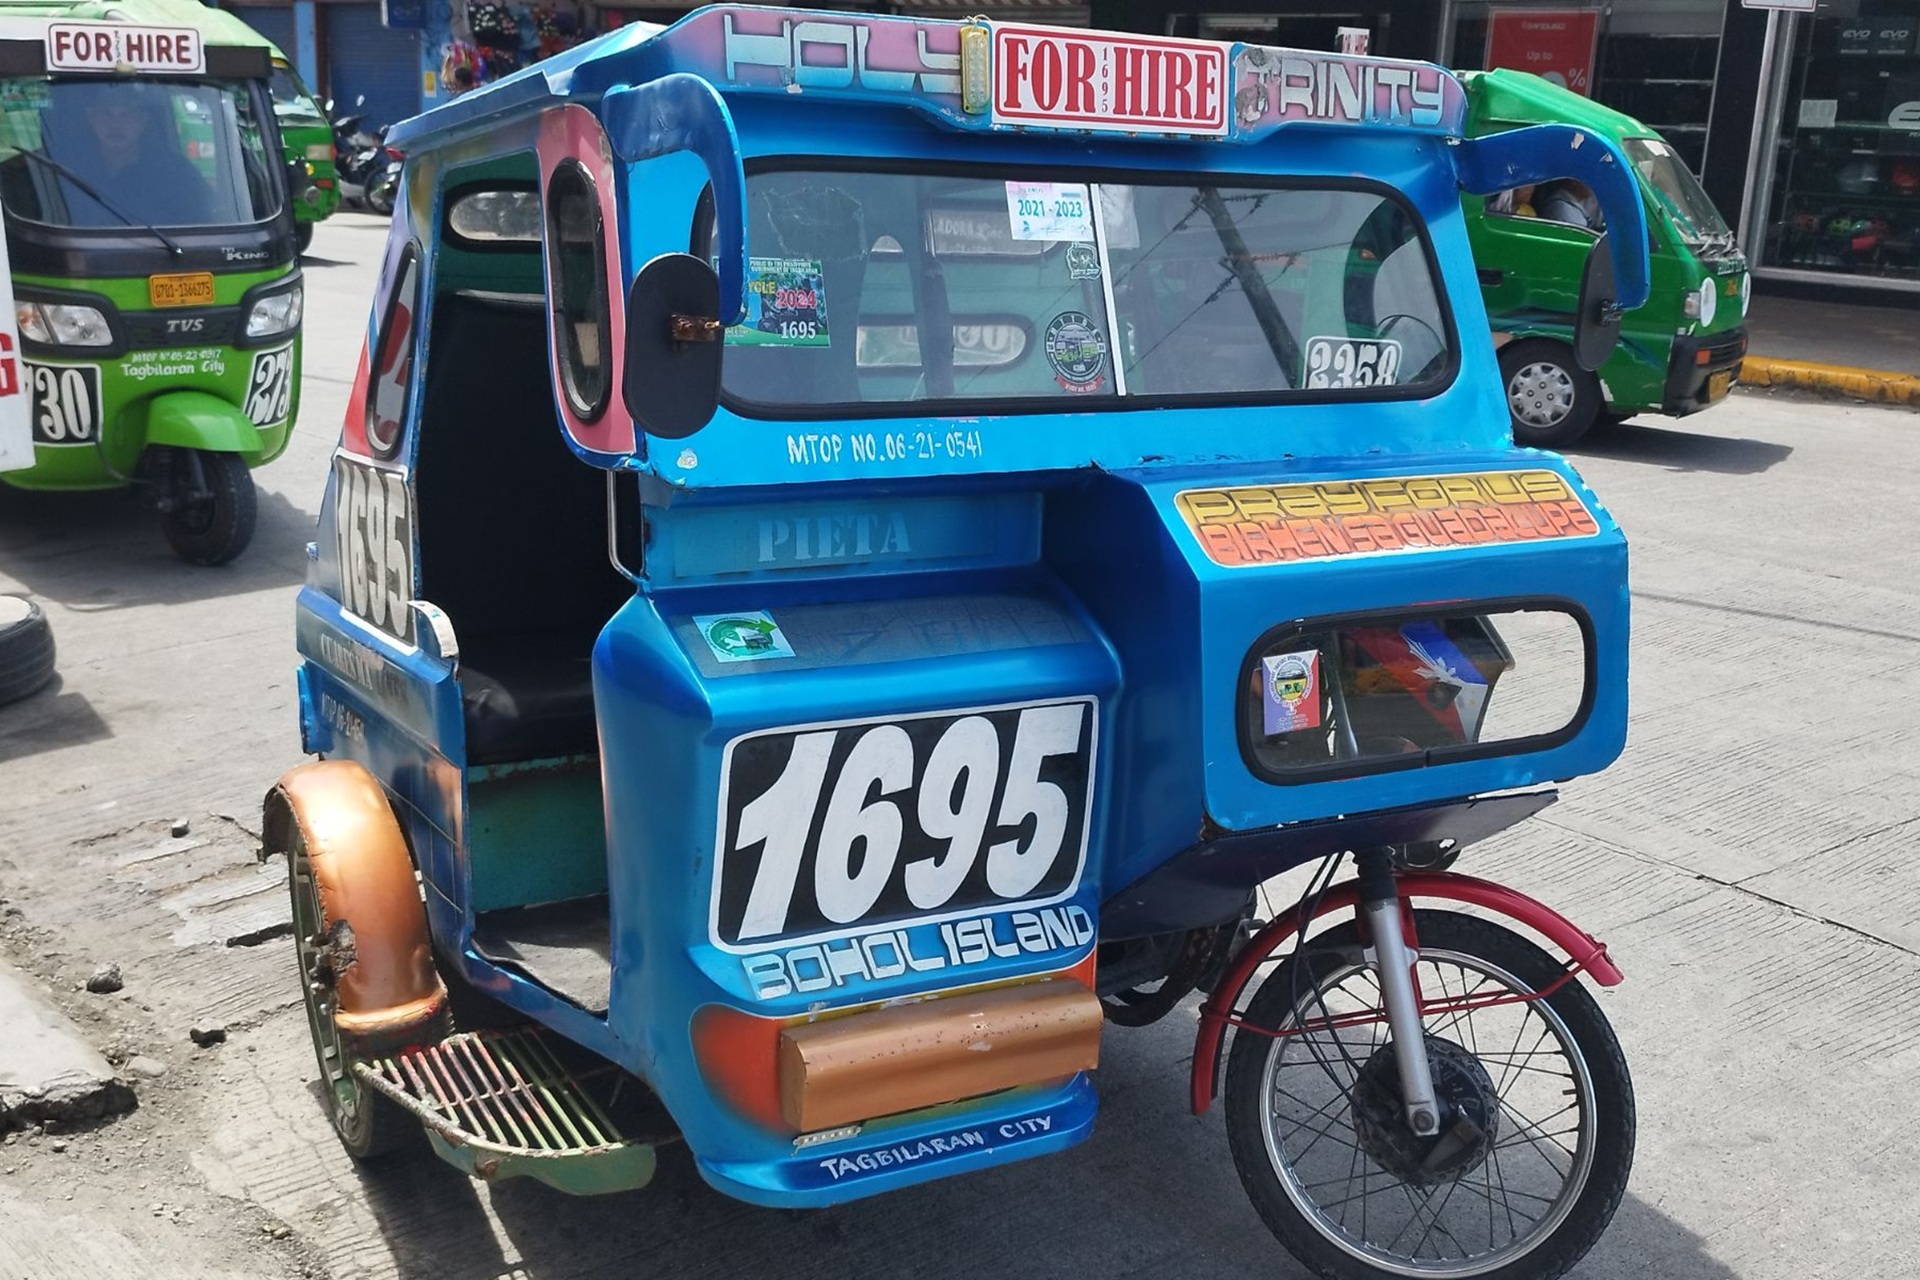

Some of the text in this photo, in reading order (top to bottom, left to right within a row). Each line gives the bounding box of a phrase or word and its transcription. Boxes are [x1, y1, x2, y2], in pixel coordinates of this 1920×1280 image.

[55, 31, 192, 64] FOR HIRE
[723, 14, 1445, 126] HOLY TRINITY
[1003, 38, 1218, 121] FOR HIRE
[1101, 46, 1109, 114] 1695
[1018, 199, 1045, 217] 2021
[1055, 201, 1083, 218] 2023
[776, 289, 817, 309] 2024
[167, 318, 204, 334] TVS
[780, 320, 816, 339] 1695
[121, 360, 225, 380] Tagbilaran City
[1309, 340, 1397, 389] 2358
[787, 433, 843, 465] MTOP
[1363, 476, 1490, 513] FOR
[1479, 471, 1568, 504] US
[337, 462, 409, 638] 1695
[758, 511, 911, 563] PIETA
[735, 703, 1085, 941] 1695
[741, 905, 1095, 1001] BOHOL ISLAND
[820, 1114, 1053, 1181] TAGBILARAN CITY
